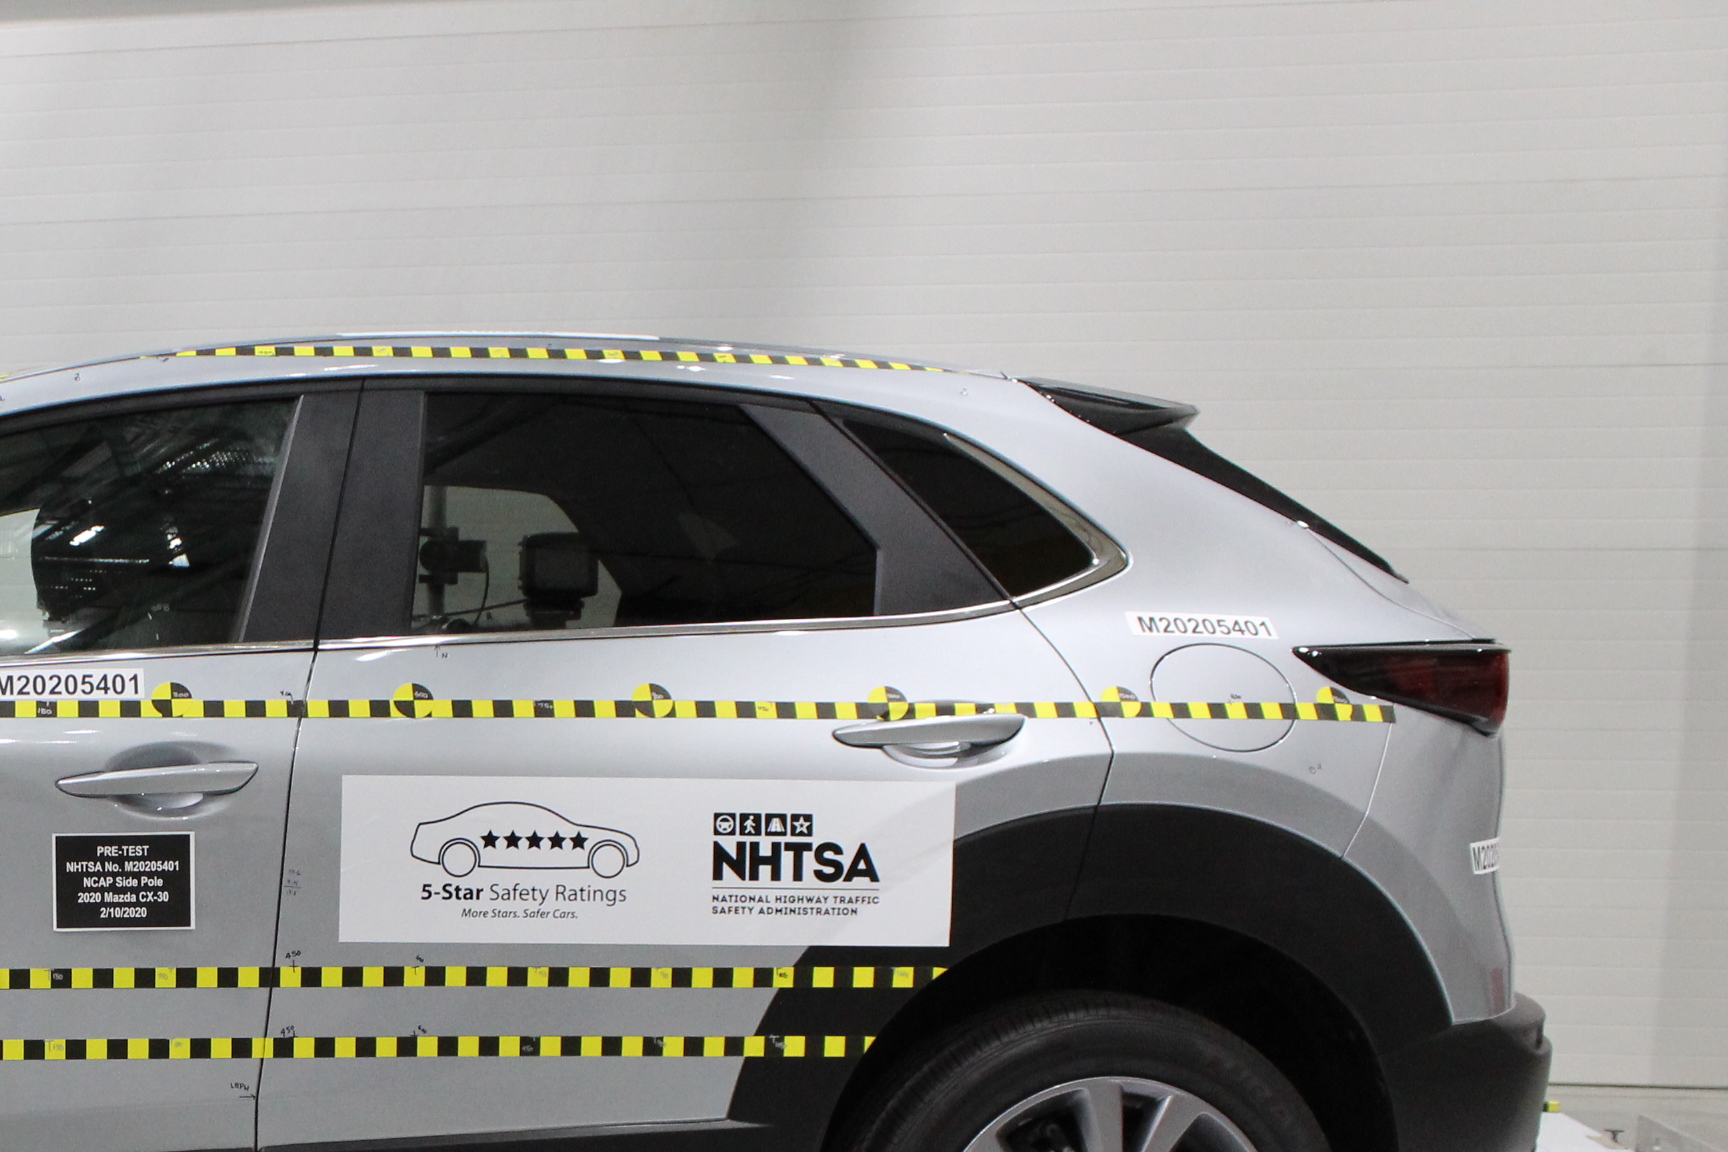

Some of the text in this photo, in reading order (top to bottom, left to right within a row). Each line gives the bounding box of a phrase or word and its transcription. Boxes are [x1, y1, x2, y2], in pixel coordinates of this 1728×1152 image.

[1136, 615, 1272, 638] M20205401
[96, 845, 150, 857] PRE-TEST
[65, 860, 180, 873] NHTSA No. M20205401
[712, 840, 880, 883] NHTSA
[83, 875, 164, 888] NCAP Side Pole
[77, 890, 170, 903] 2020 Mazda CX-30
[421, 882, 628, 907] 5-Star Safety Ratings
[712, 894, 880, 905] NATIONAL HIGHWAY TRAFFIC
[99, 906, 148, 919] 2/10/2020
[461, 907, 579, 920] More Stars. Safer Cars.
[711, 905, 859, 917] SAFETY ADMINISTRATION
